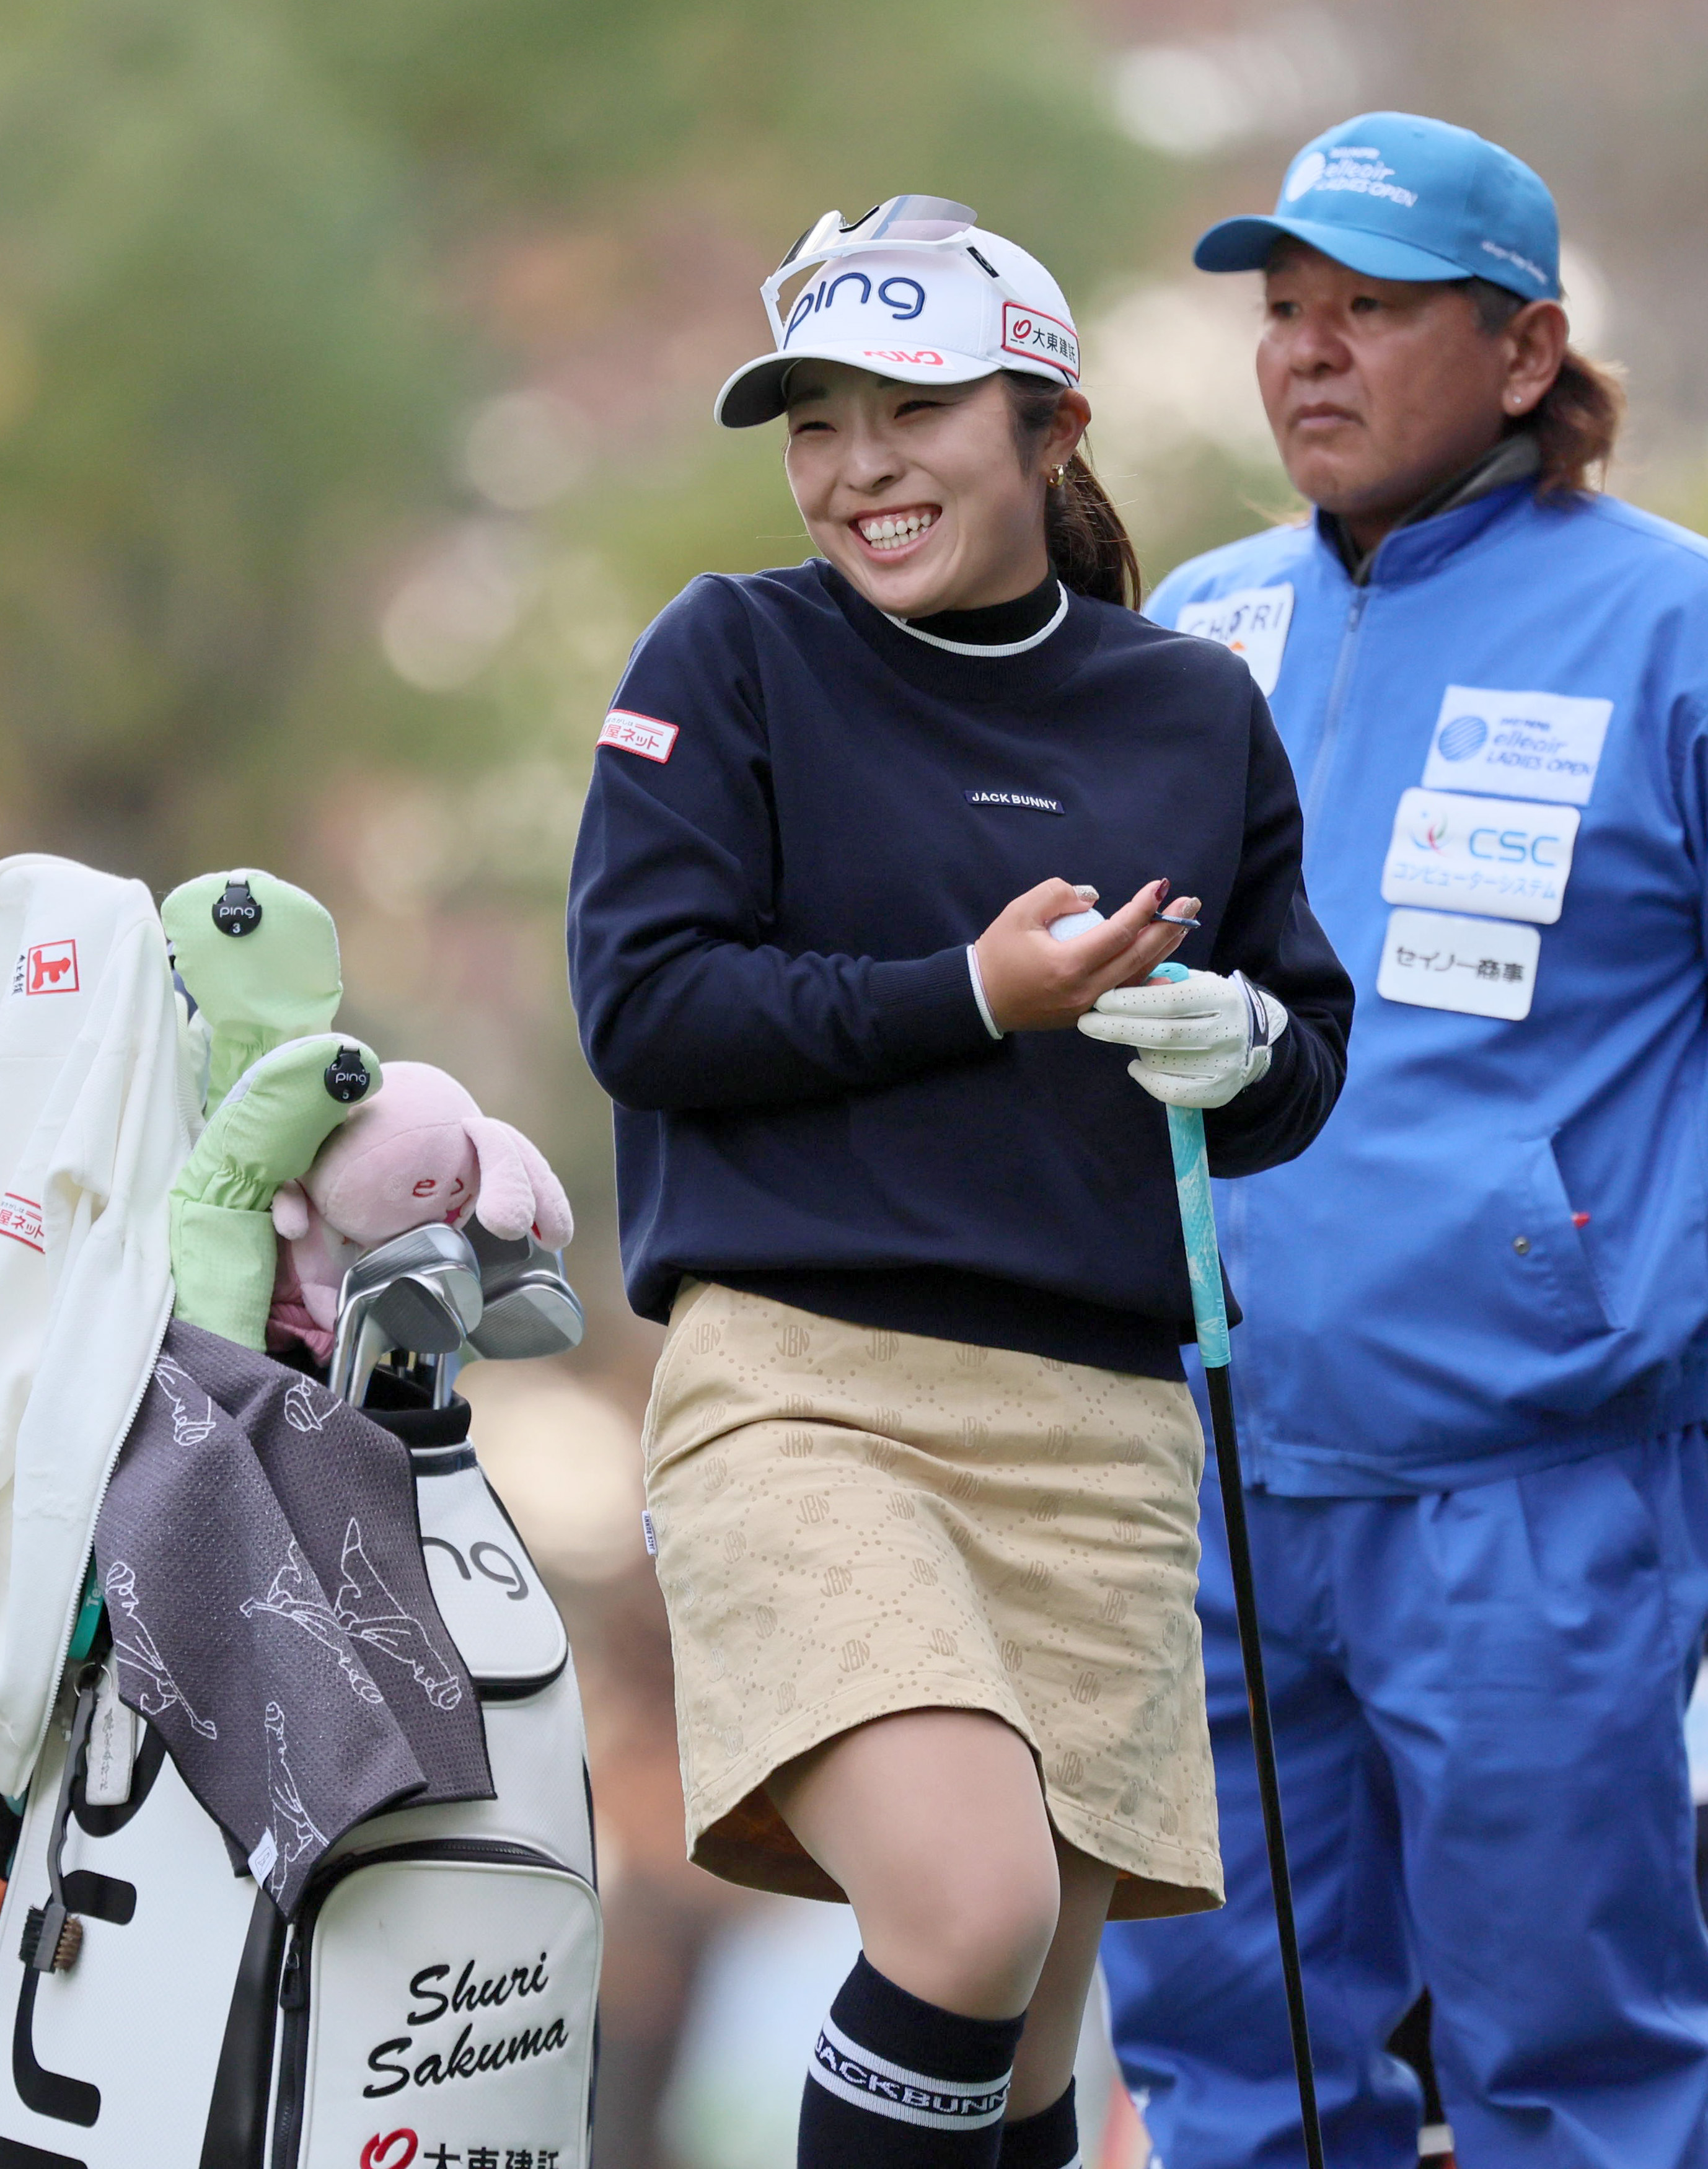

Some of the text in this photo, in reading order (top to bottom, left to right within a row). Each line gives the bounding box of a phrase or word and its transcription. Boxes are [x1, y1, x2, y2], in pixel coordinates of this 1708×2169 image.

[783, 272, 925, 350] ping
[1032, 328, 1076, 364] 大東建託
[972, 793, 1057, 810] JACK BUNNY
[1469, 828, 1559, 867] CSC
[219, 907, 255, 918] ping
[232, 923, 240, 933] 3
[335, 1073, 366, 1085] ping
[644, 1516, 653, 1534] BUNNY
[421, 1536, 529, 1601] ng
[407, 1952, 548, 2026] Shuri
[363, 2018, 569, 2098] Sakuma
[814, 2035, 900, 2100] JACK
